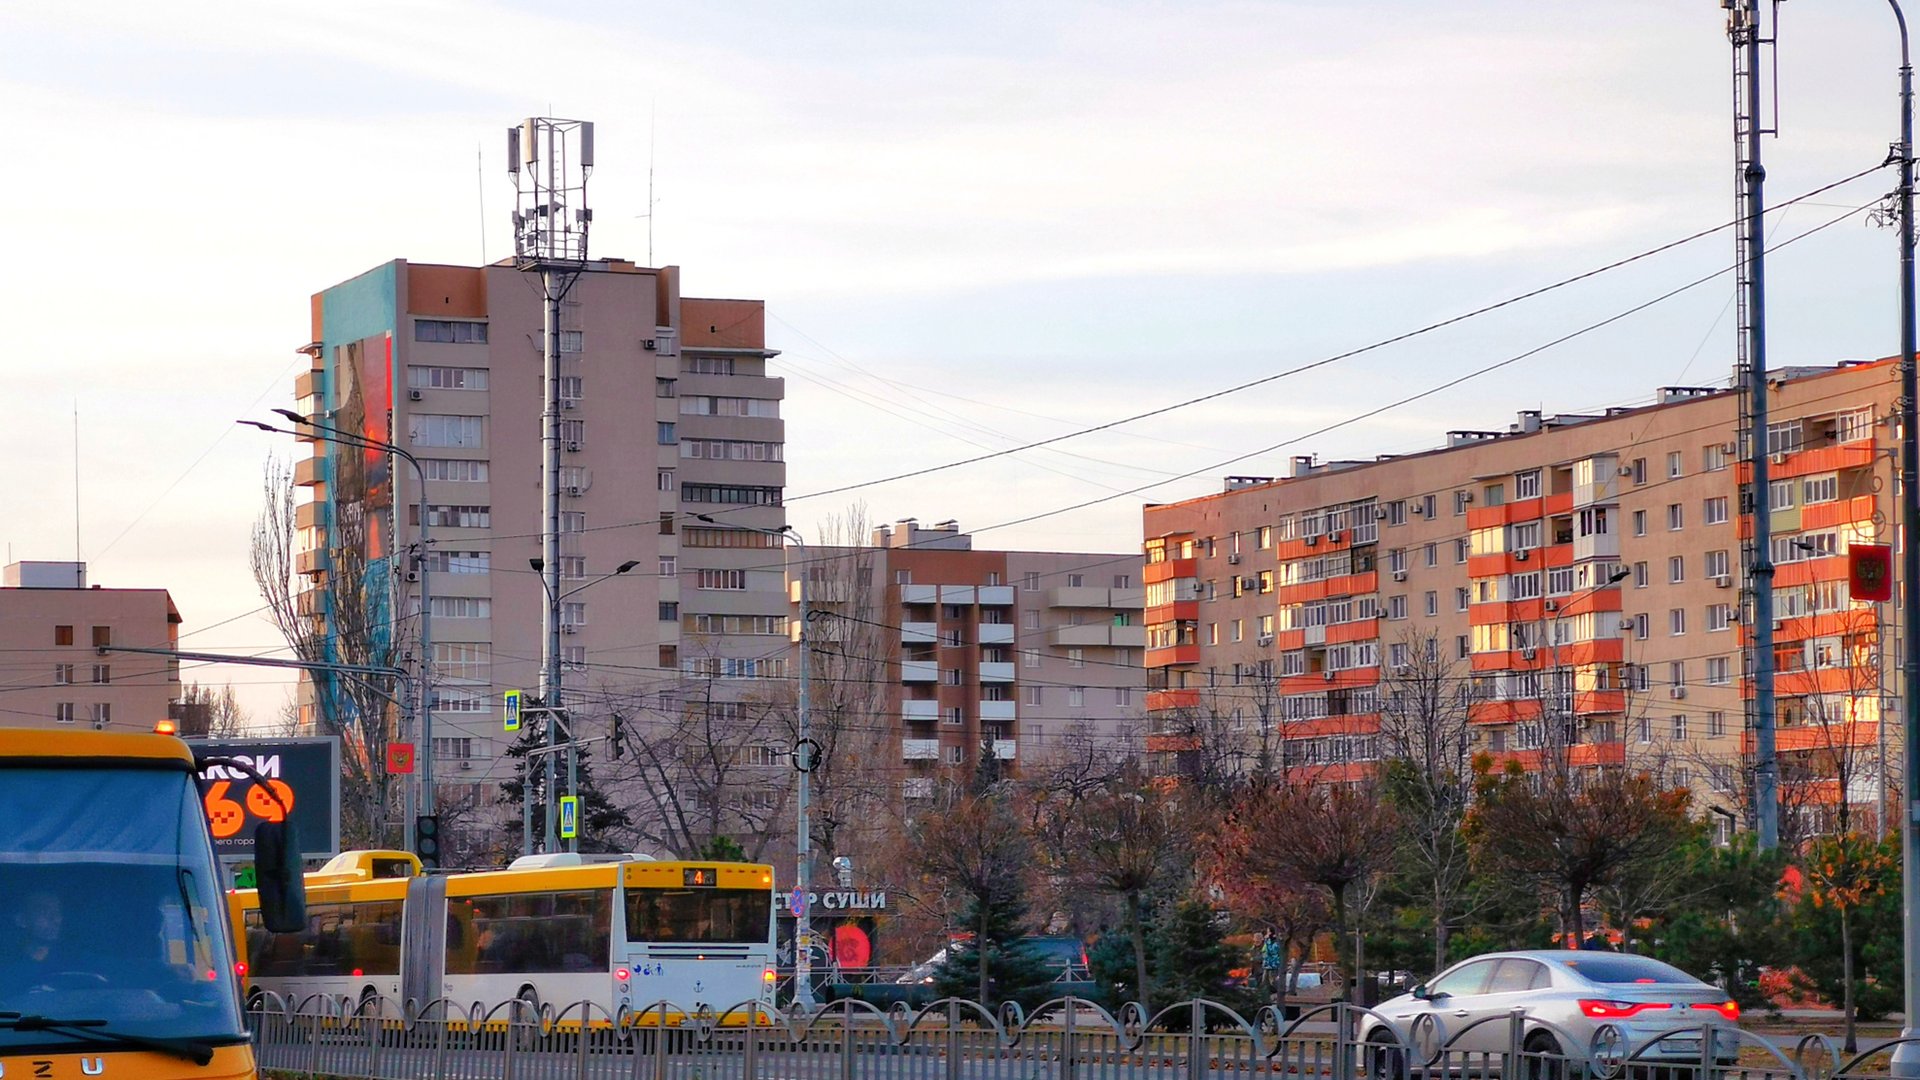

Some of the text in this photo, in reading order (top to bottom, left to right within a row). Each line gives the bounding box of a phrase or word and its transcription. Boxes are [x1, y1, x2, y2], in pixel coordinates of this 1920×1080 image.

[694, 870, 703, 884] 4
[774, 892, 886, 909] СТР СУШИ
[0, 1057, 104, 1078] ZU
